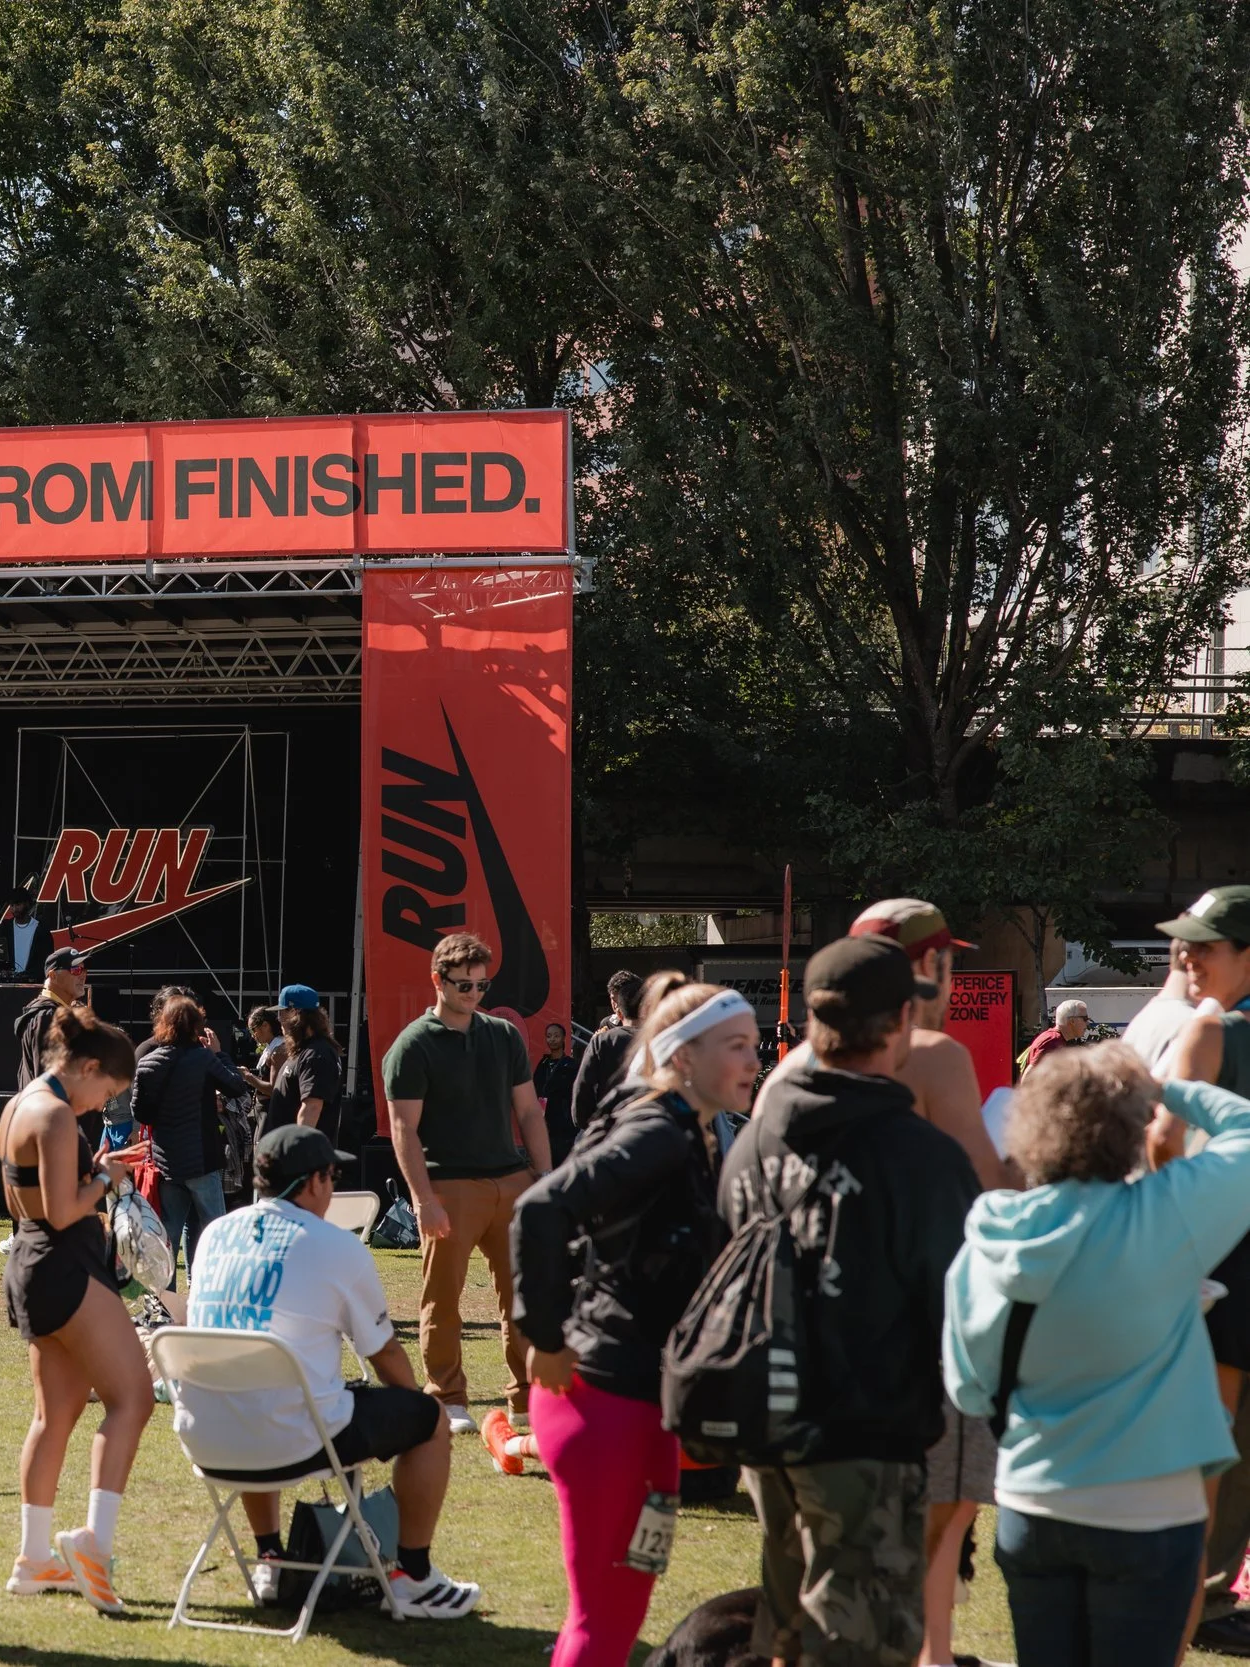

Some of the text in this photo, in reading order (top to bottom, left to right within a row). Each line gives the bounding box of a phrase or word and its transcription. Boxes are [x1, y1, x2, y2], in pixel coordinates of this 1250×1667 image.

[176, 453, 539, 519] FINISHED.
[37, 828, 211, 904] RUN
[381, 746, 467, 953] RUN
[950, 992, 1008, 1006] COVERY
[951, 976, 1004, 990] PERICE
[950, 1007, 989, 1021] ZONE
